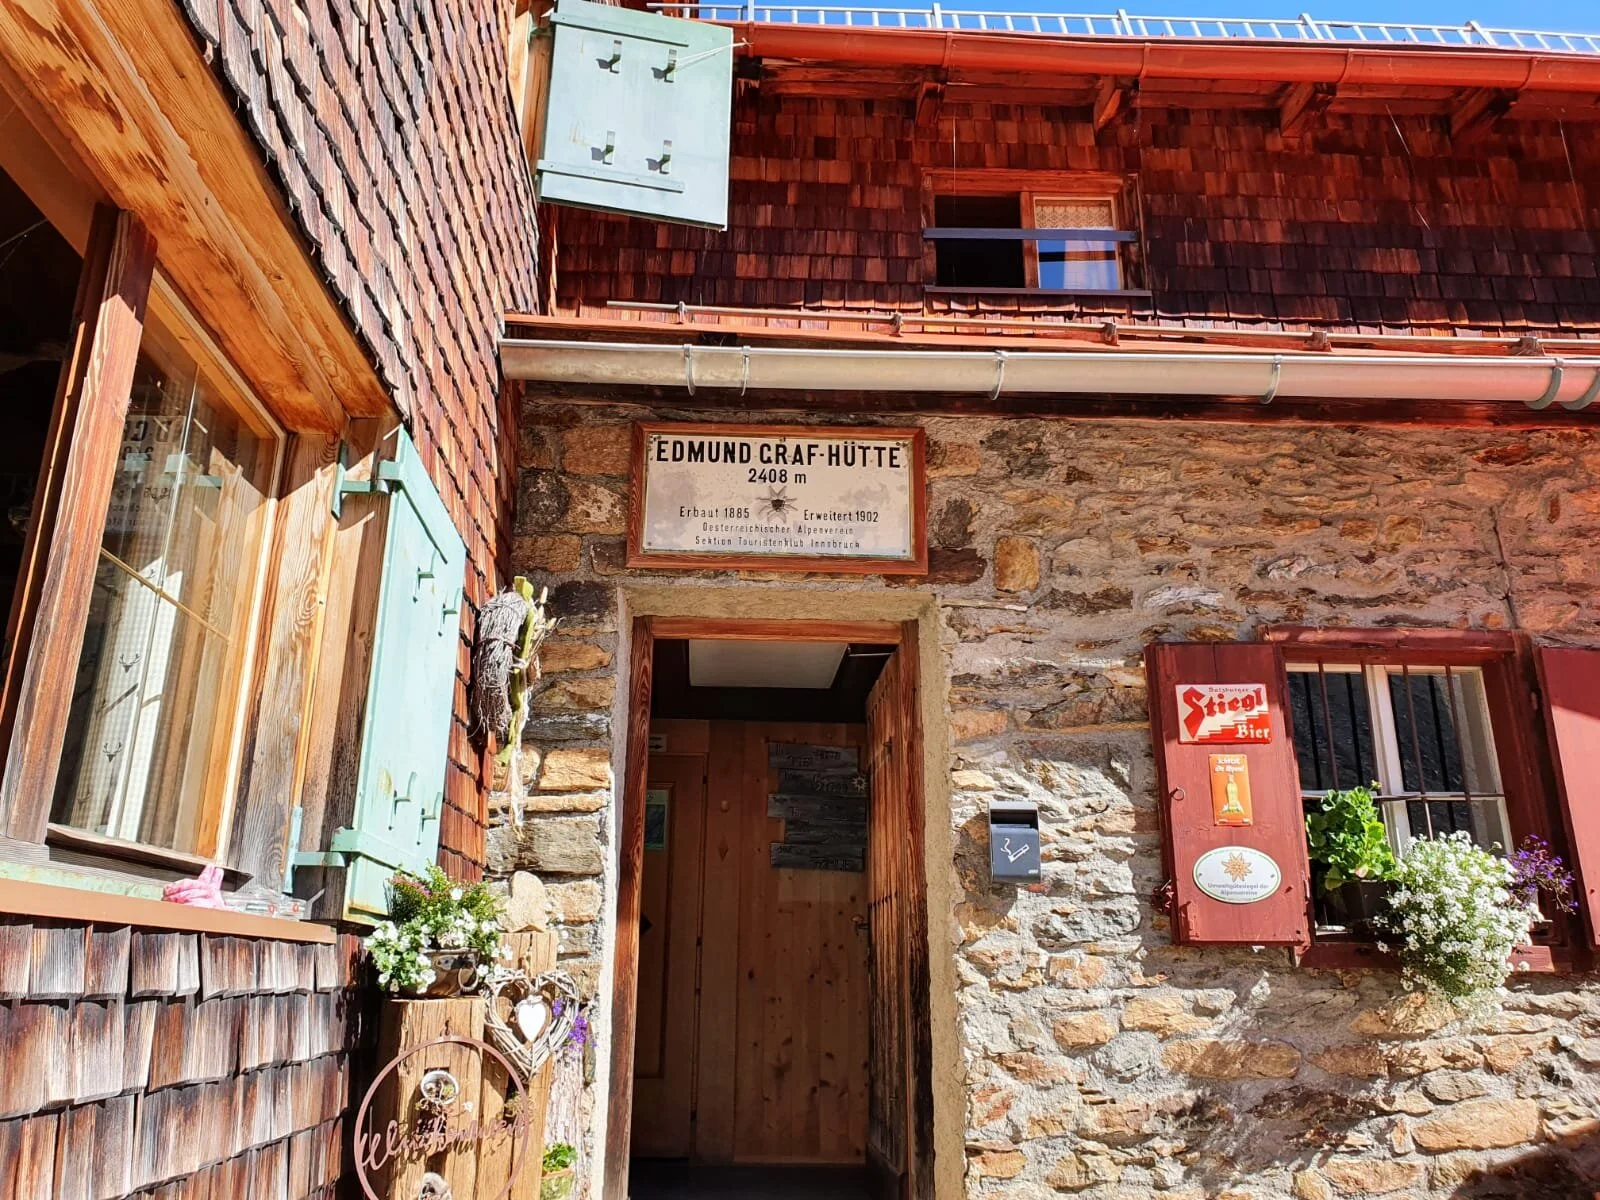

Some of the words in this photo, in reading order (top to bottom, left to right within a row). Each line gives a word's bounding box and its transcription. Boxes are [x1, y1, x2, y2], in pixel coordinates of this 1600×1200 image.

[656, 440, 751, 464] EDMUND
[759, 441, 901, 469] GRAF-HÜTTE
[748, 468, 788, 484] 2408
[794, 472, 807, 484] m
[679, 506, 719, 519] Erbaut
[724, 507, 750, 519] 1885
[803, 509, 853, 522] Erweitert
[855, 510, 879, 523] 1902
[702, 522, 790, 534] Oesterreichischer
[797, 525, 854, 537] Alpenverein
[695, 536, 732, 546] Sektion
[738, 537, 804, 549] Touristenklub
[810, 539, 860, 550] Innsbruck
[1183, 687, 1264, 738] Stiegl
[1235, 723, 1270, 739] Bier
